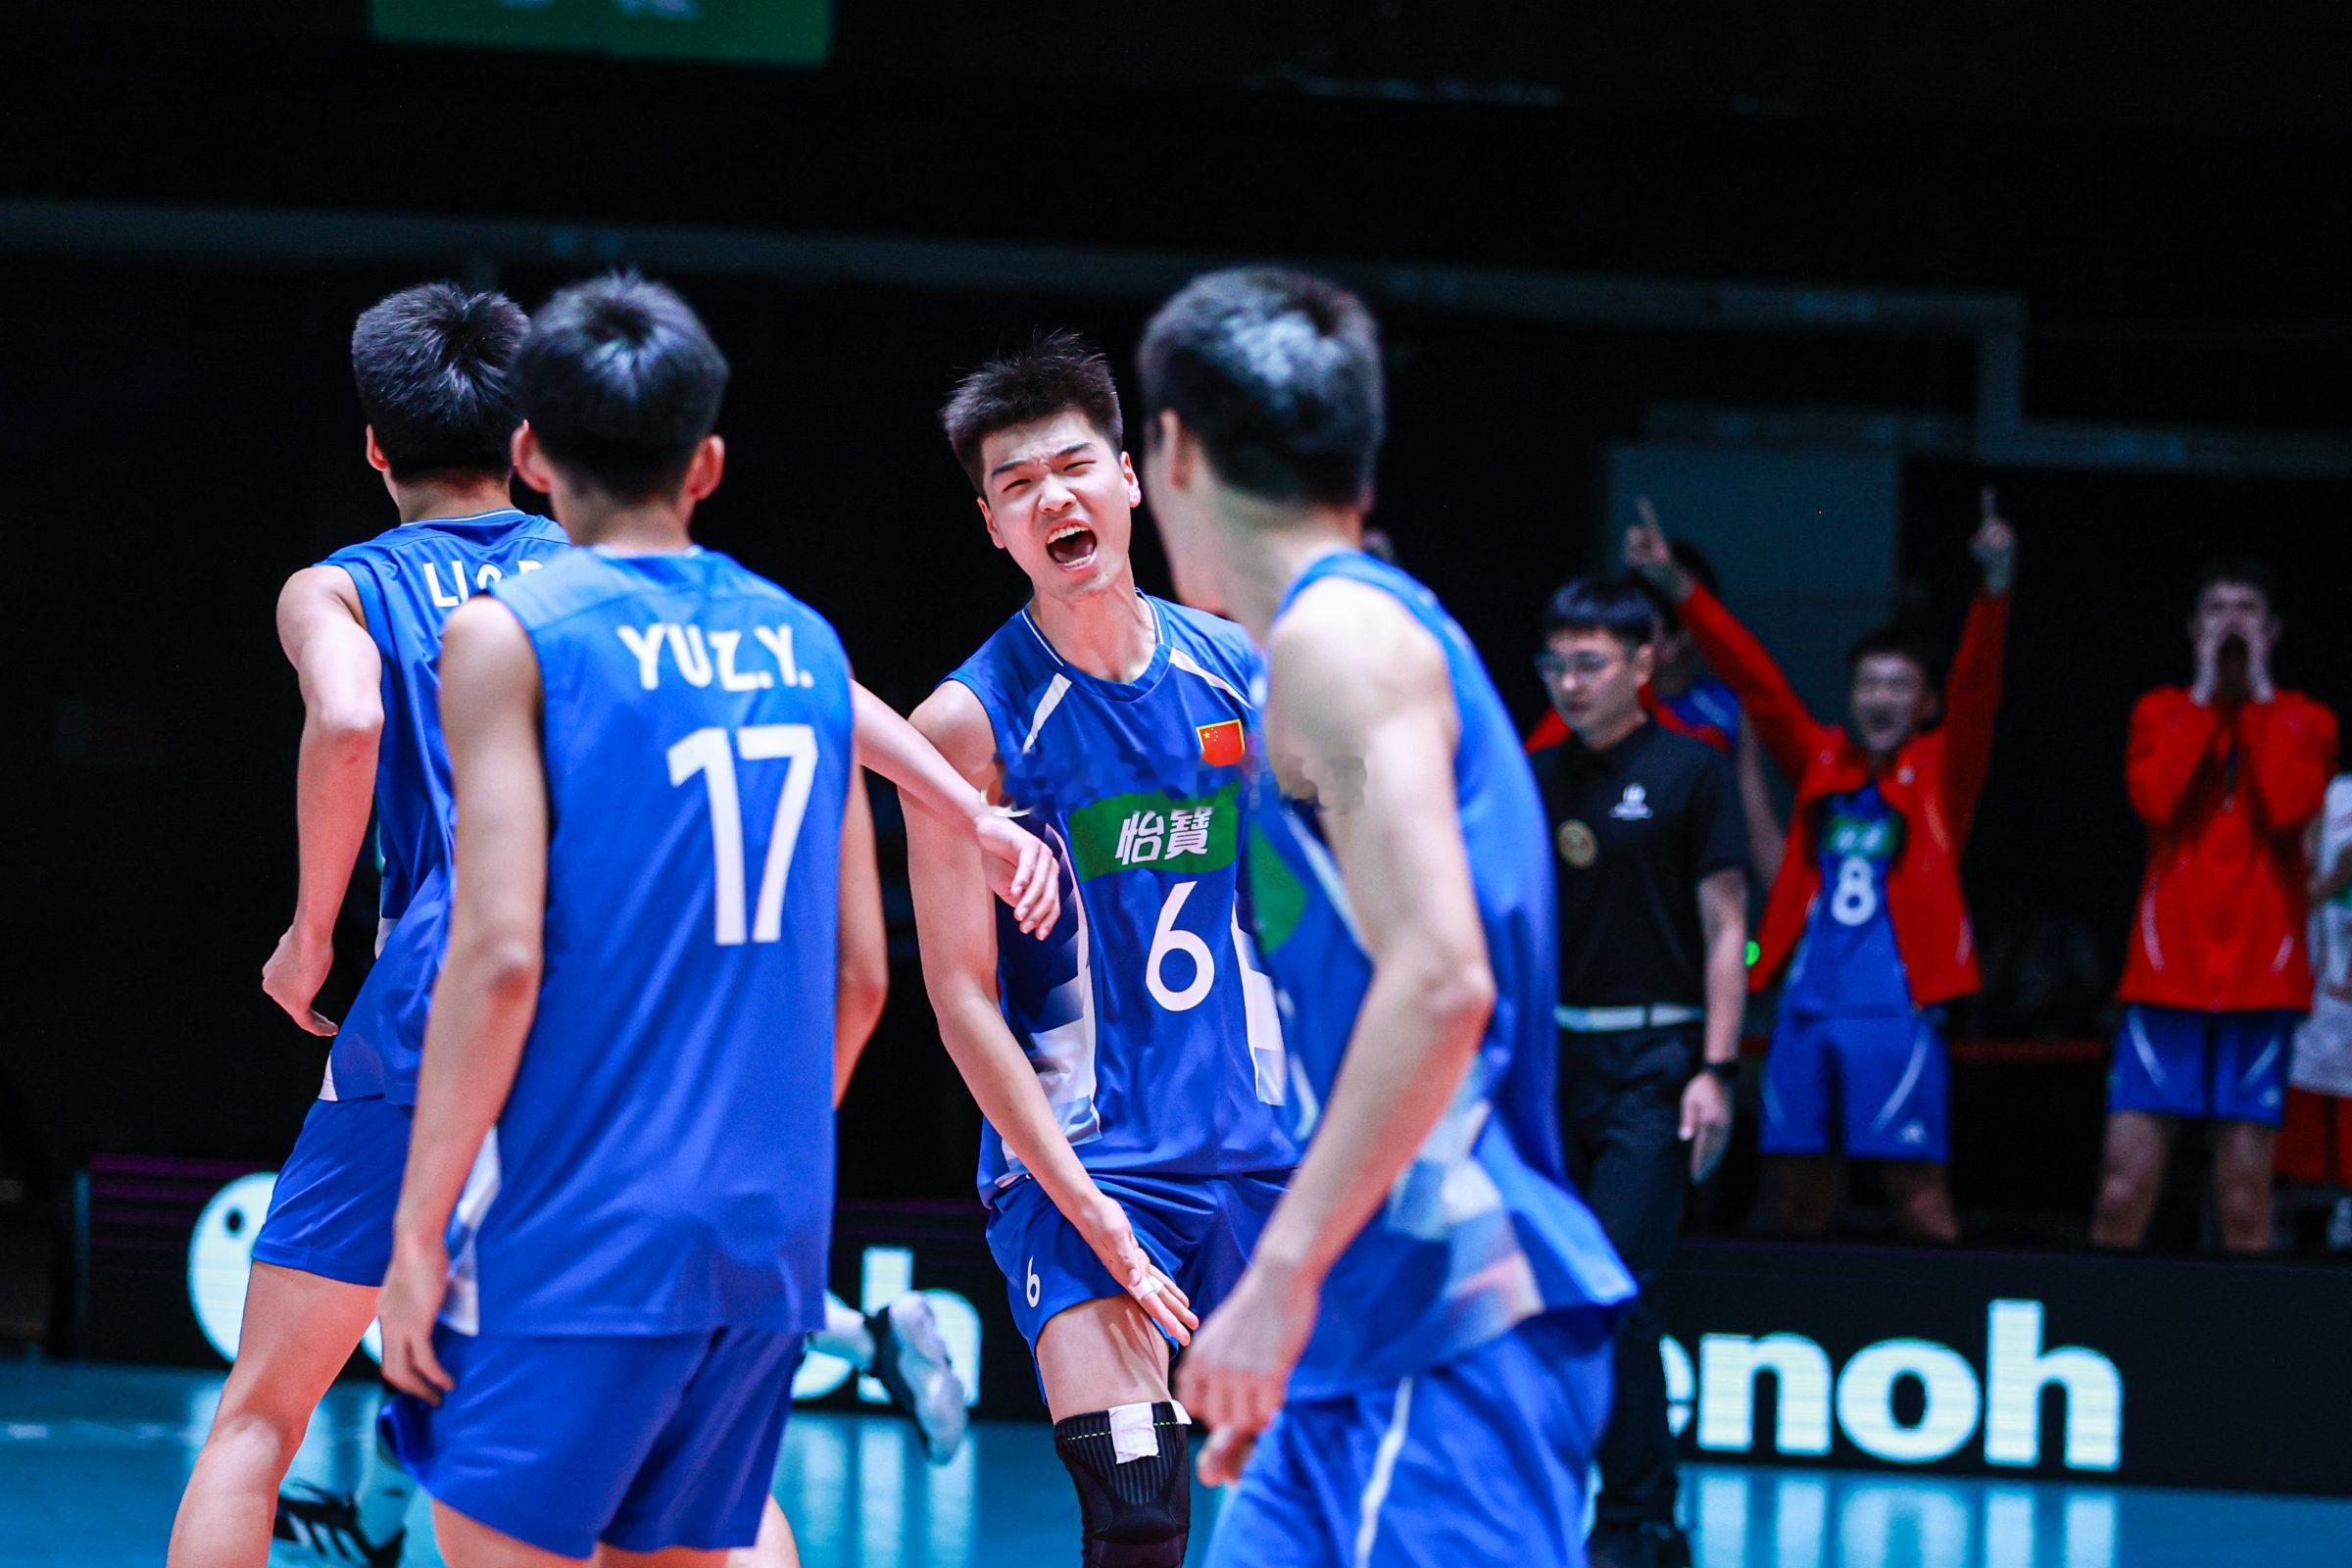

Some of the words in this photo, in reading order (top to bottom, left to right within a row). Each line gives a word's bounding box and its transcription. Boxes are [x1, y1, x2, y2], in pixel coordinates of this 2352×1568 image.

[666, 724, 819, 947] 17
[1114, 806, 1215, 866] 怡寶
[1830, 855, 1878, 927] 8
[1145, 880, 1215, 1011] 6
[1026, 1254, 1041, 1308] 6
